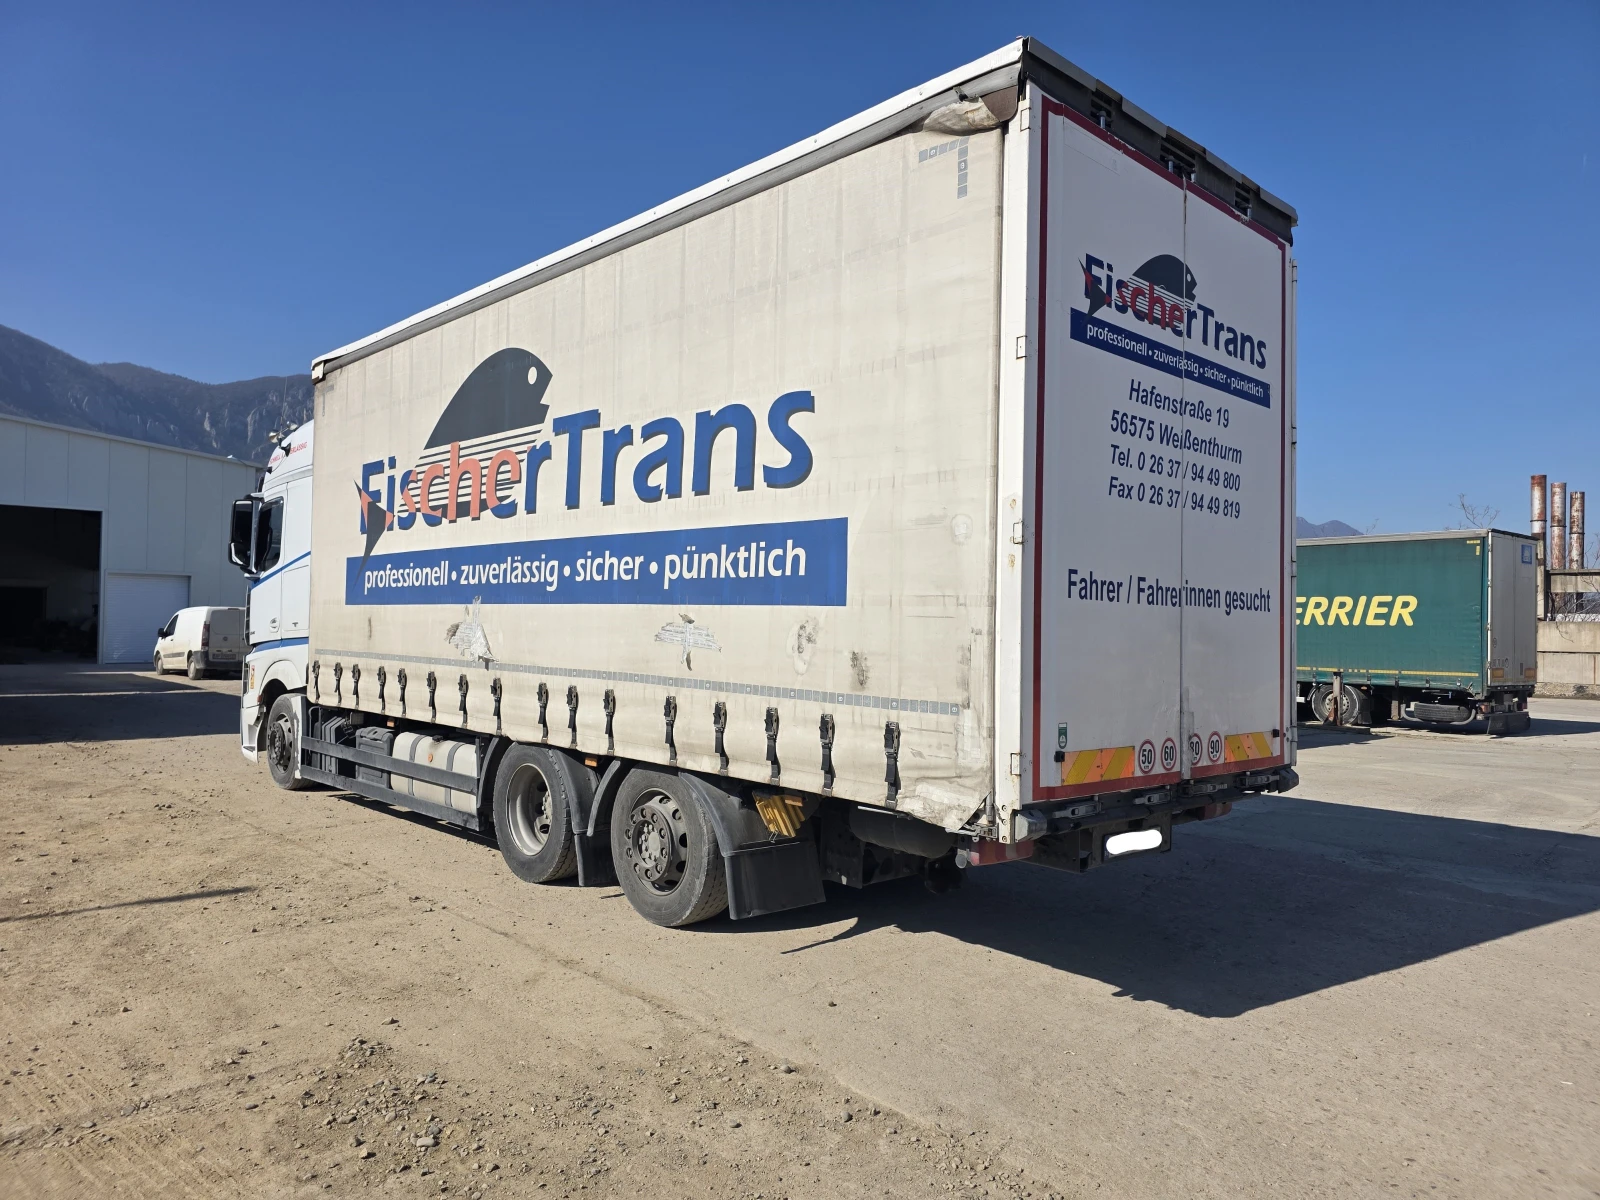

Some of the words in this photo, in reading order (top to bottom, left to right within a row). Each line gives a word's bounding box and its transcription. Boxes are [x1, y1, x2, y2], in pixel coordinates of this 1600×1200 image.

[1085, 253, 1267, 370] FischerTrans
[1087, 324, 1148, 356] professionell
[1153, 349, 1199, 377] zuverlässig
[1204, 365, 1227, 384] sicher
[1231, 377, 1264, 398] pünktlich
[1129, 379, 1213, 423] Hafenstraße
[1216, 406, 1230, 429] 19
[1110, 409, 1155, 442] 56575
[1160, 422, 1243, 465] Weißenthurm
[360, 390, 816, 536] FischerTrans
[1110, 444, 1133, 469] Tel.
[1138, 451, 1146, 471] 0
[1149, 454, 1164, 475] 26
[1167, 458, 1182, 479] 37
[1191, 462, 1205, 483] 94
[1207, 467, 1220, 487] 49
[1223, 471, 1241, 492] 800
[1108, 476, 1135, 500] Fax
[1138, 482, 1145, 502] 0
[1149, 484, 1164, 506] 26
[1167, 488, 1181, 509] 37
[1191, 492, 1205, 512] 94
[1207, 496, 1220, 515] 49
[1223, 499, 1240, 519] 819
[364, 560, 449, 595] professionell
[460, 554, 559, 592] zuverlässig
[575, 550, 644, 582] sicher
[663, 539, 806, 590] pünktlich
[1067, 568, 1124, 603] Fahrer
[1224, 587, 1271, 616] gesucht
[1141, 748, 1153, 765] 50
[1163, 745, 1174, 762] 60
[1210, 739, 1220, 755] 90
